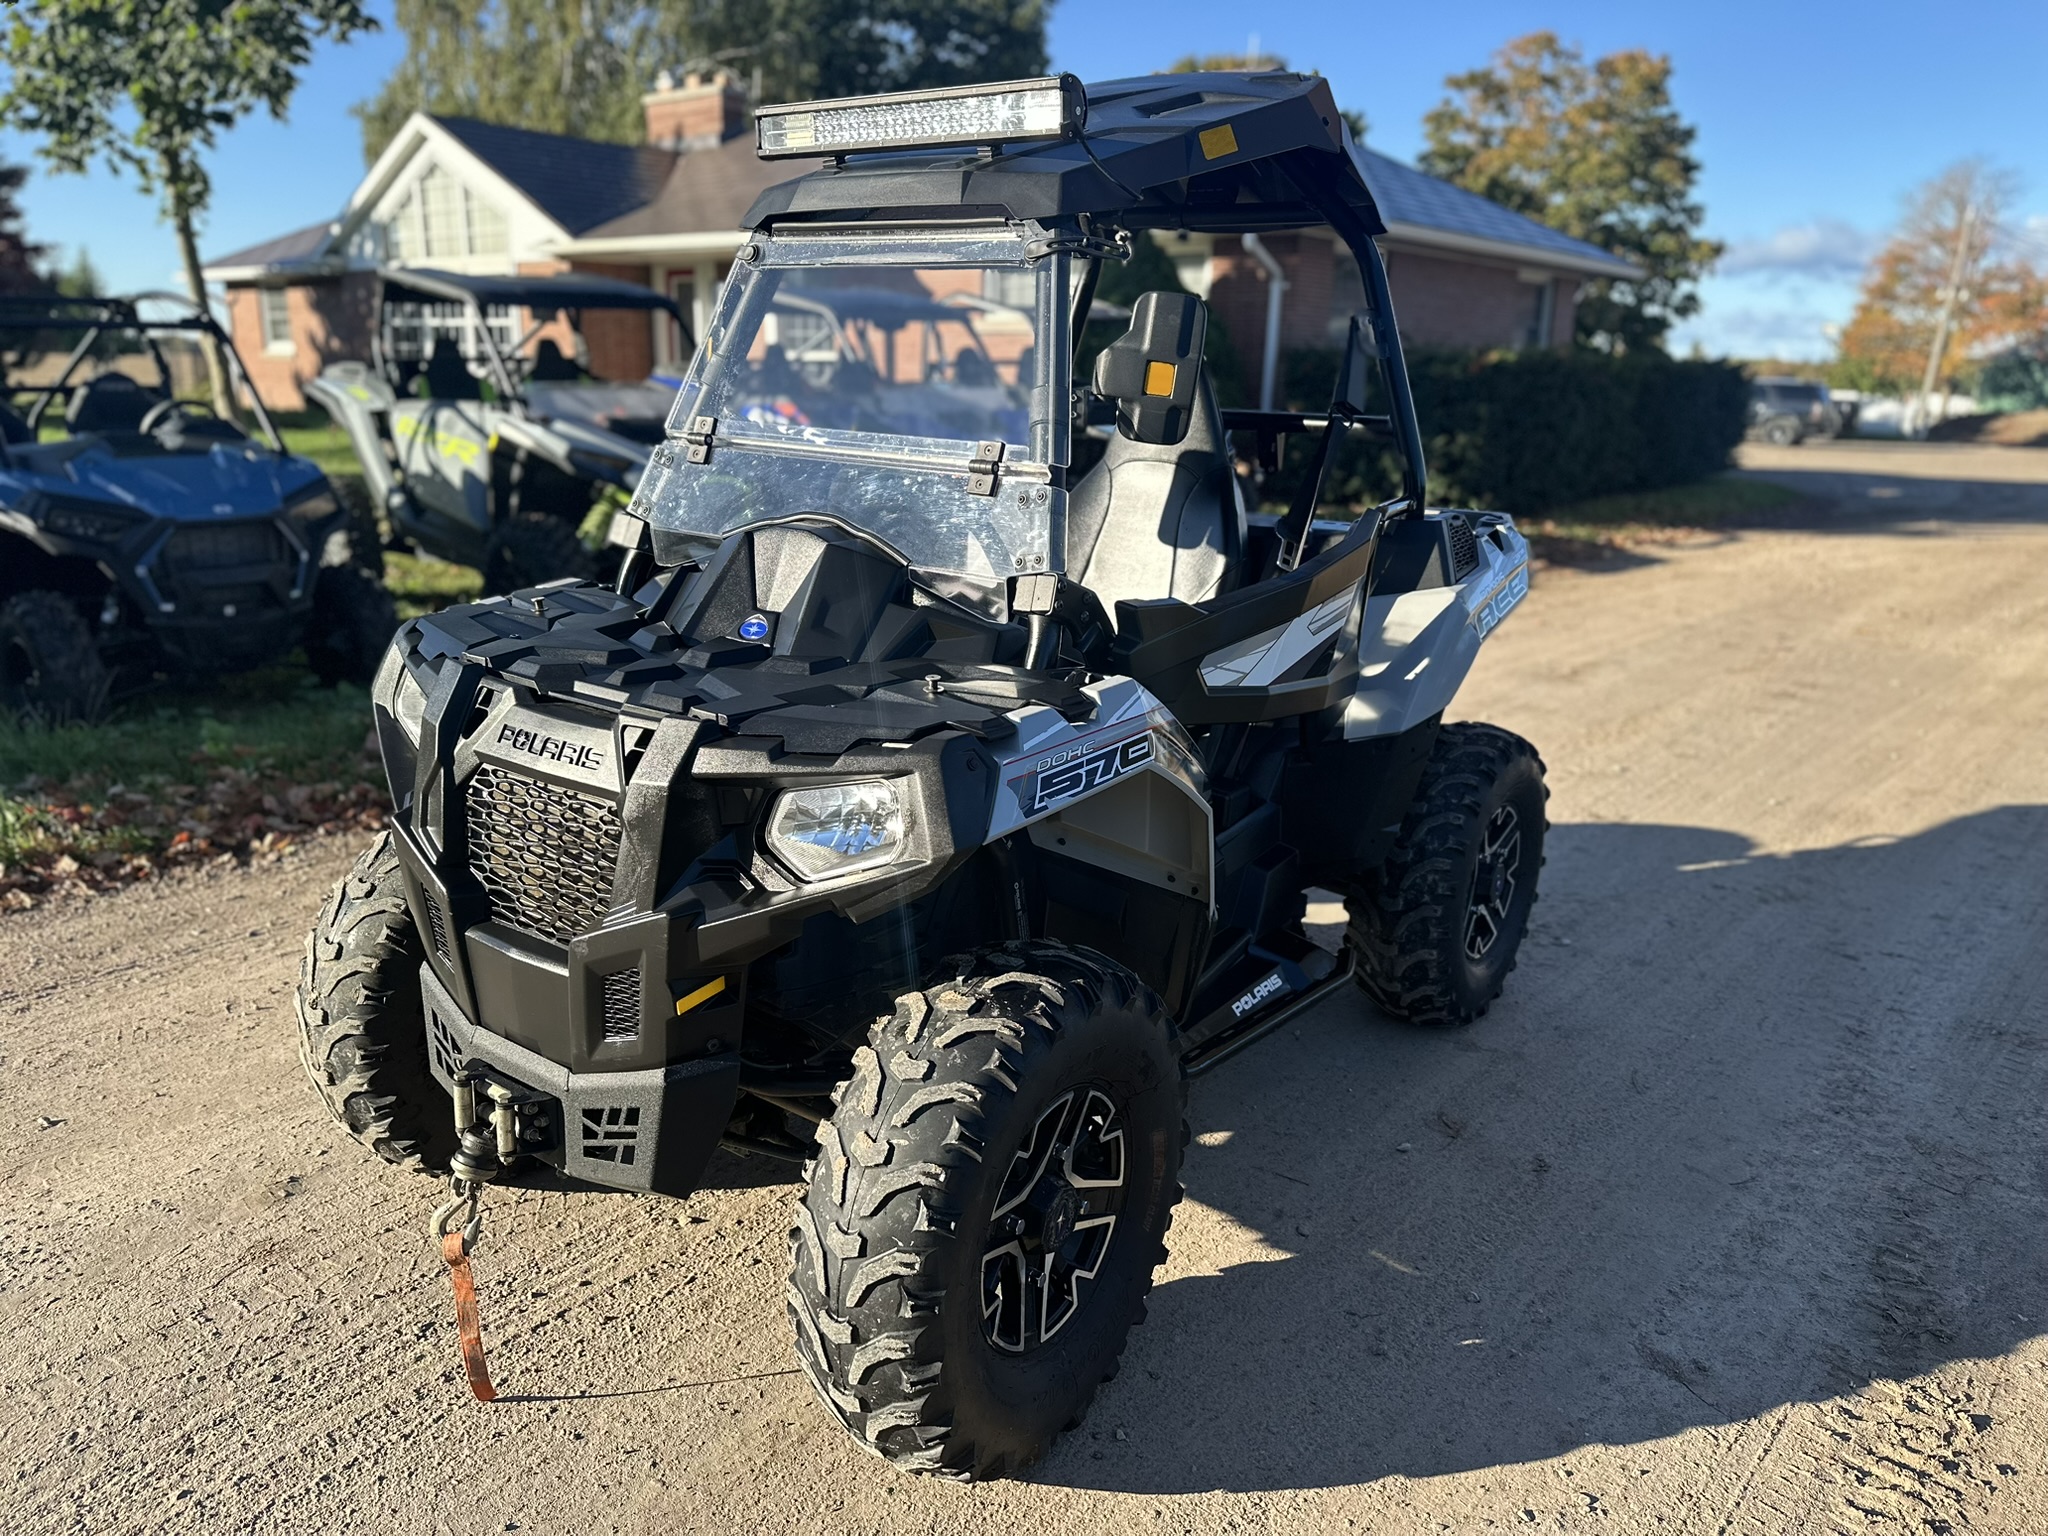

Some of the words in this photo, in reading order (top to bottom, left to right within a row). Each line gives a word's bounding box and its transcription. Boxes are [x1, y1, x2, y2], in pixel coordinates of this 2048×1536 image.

[1475, 565, 1529, 639] ACE
[497, 723, 605, 771] POLARIS
[1033, 729, 1156, 810] 570
[1036, 740, 1096, 773] DOHC
[1231, 973, 1283, 1017] POLARIS
